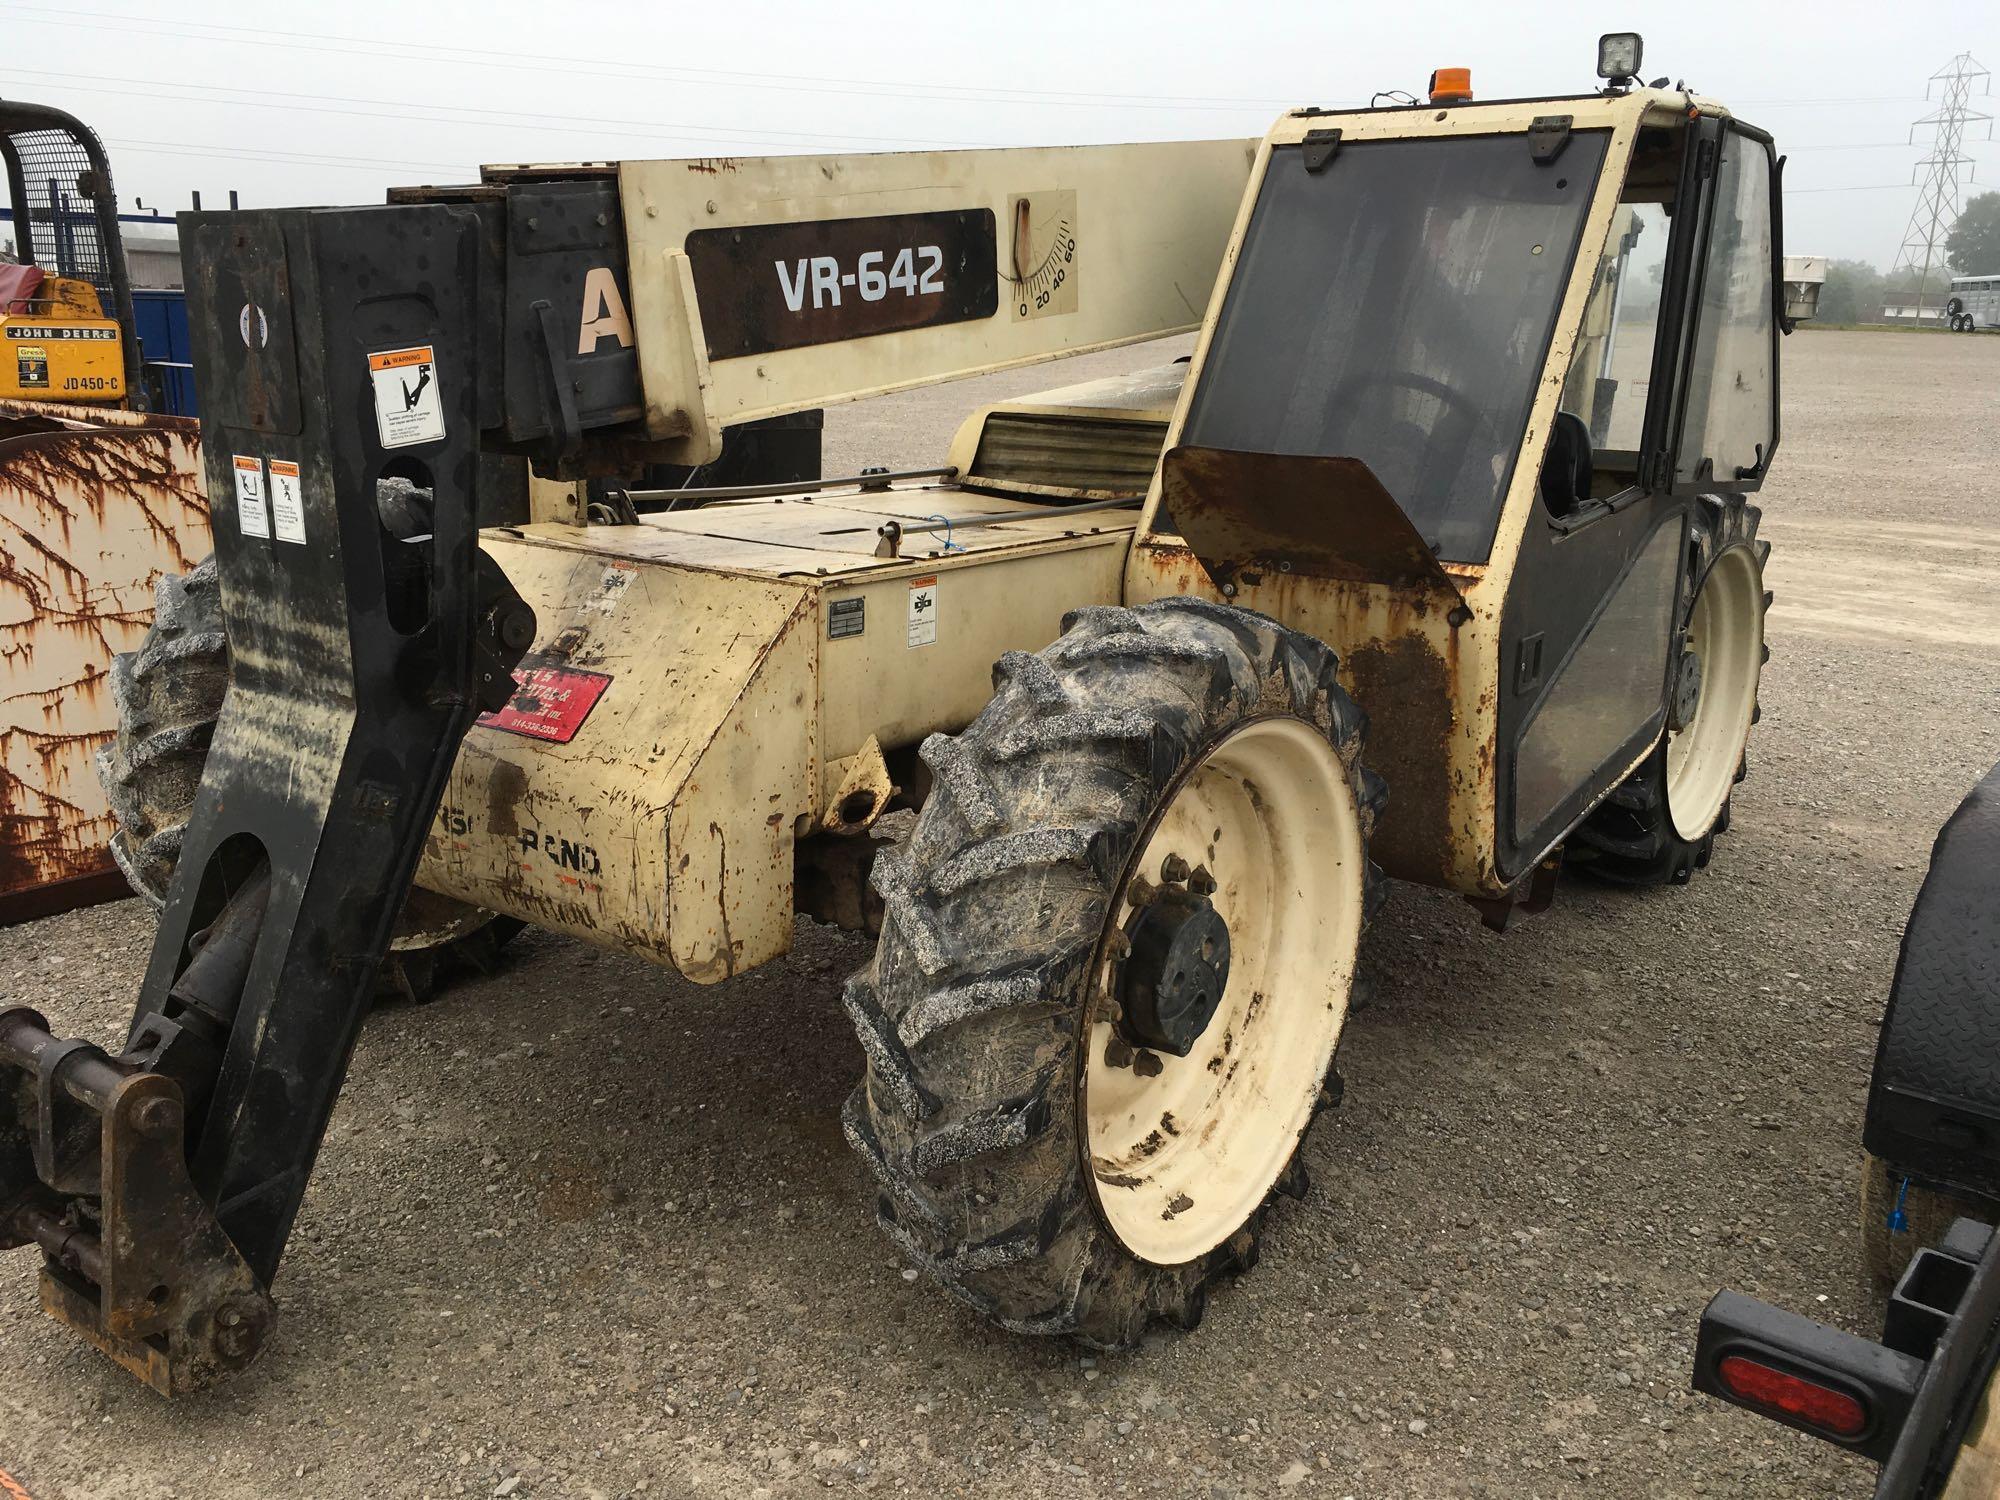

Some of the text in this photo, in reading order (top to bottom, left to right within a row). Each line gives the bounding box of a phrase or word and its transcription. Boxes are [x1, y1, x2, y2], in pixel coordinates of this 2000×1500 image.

[775, 246, 944, 312] VR-642
[1035, 290, 1050, 310] 20
[1053, 268, 1065, 291] 40
[1064, 238, 1075, 263] 60
[16, 328, 110, 338] JOHN DEERE
[578, 267, 635, 354] A
[392, 354, 421, 364] WARNING
